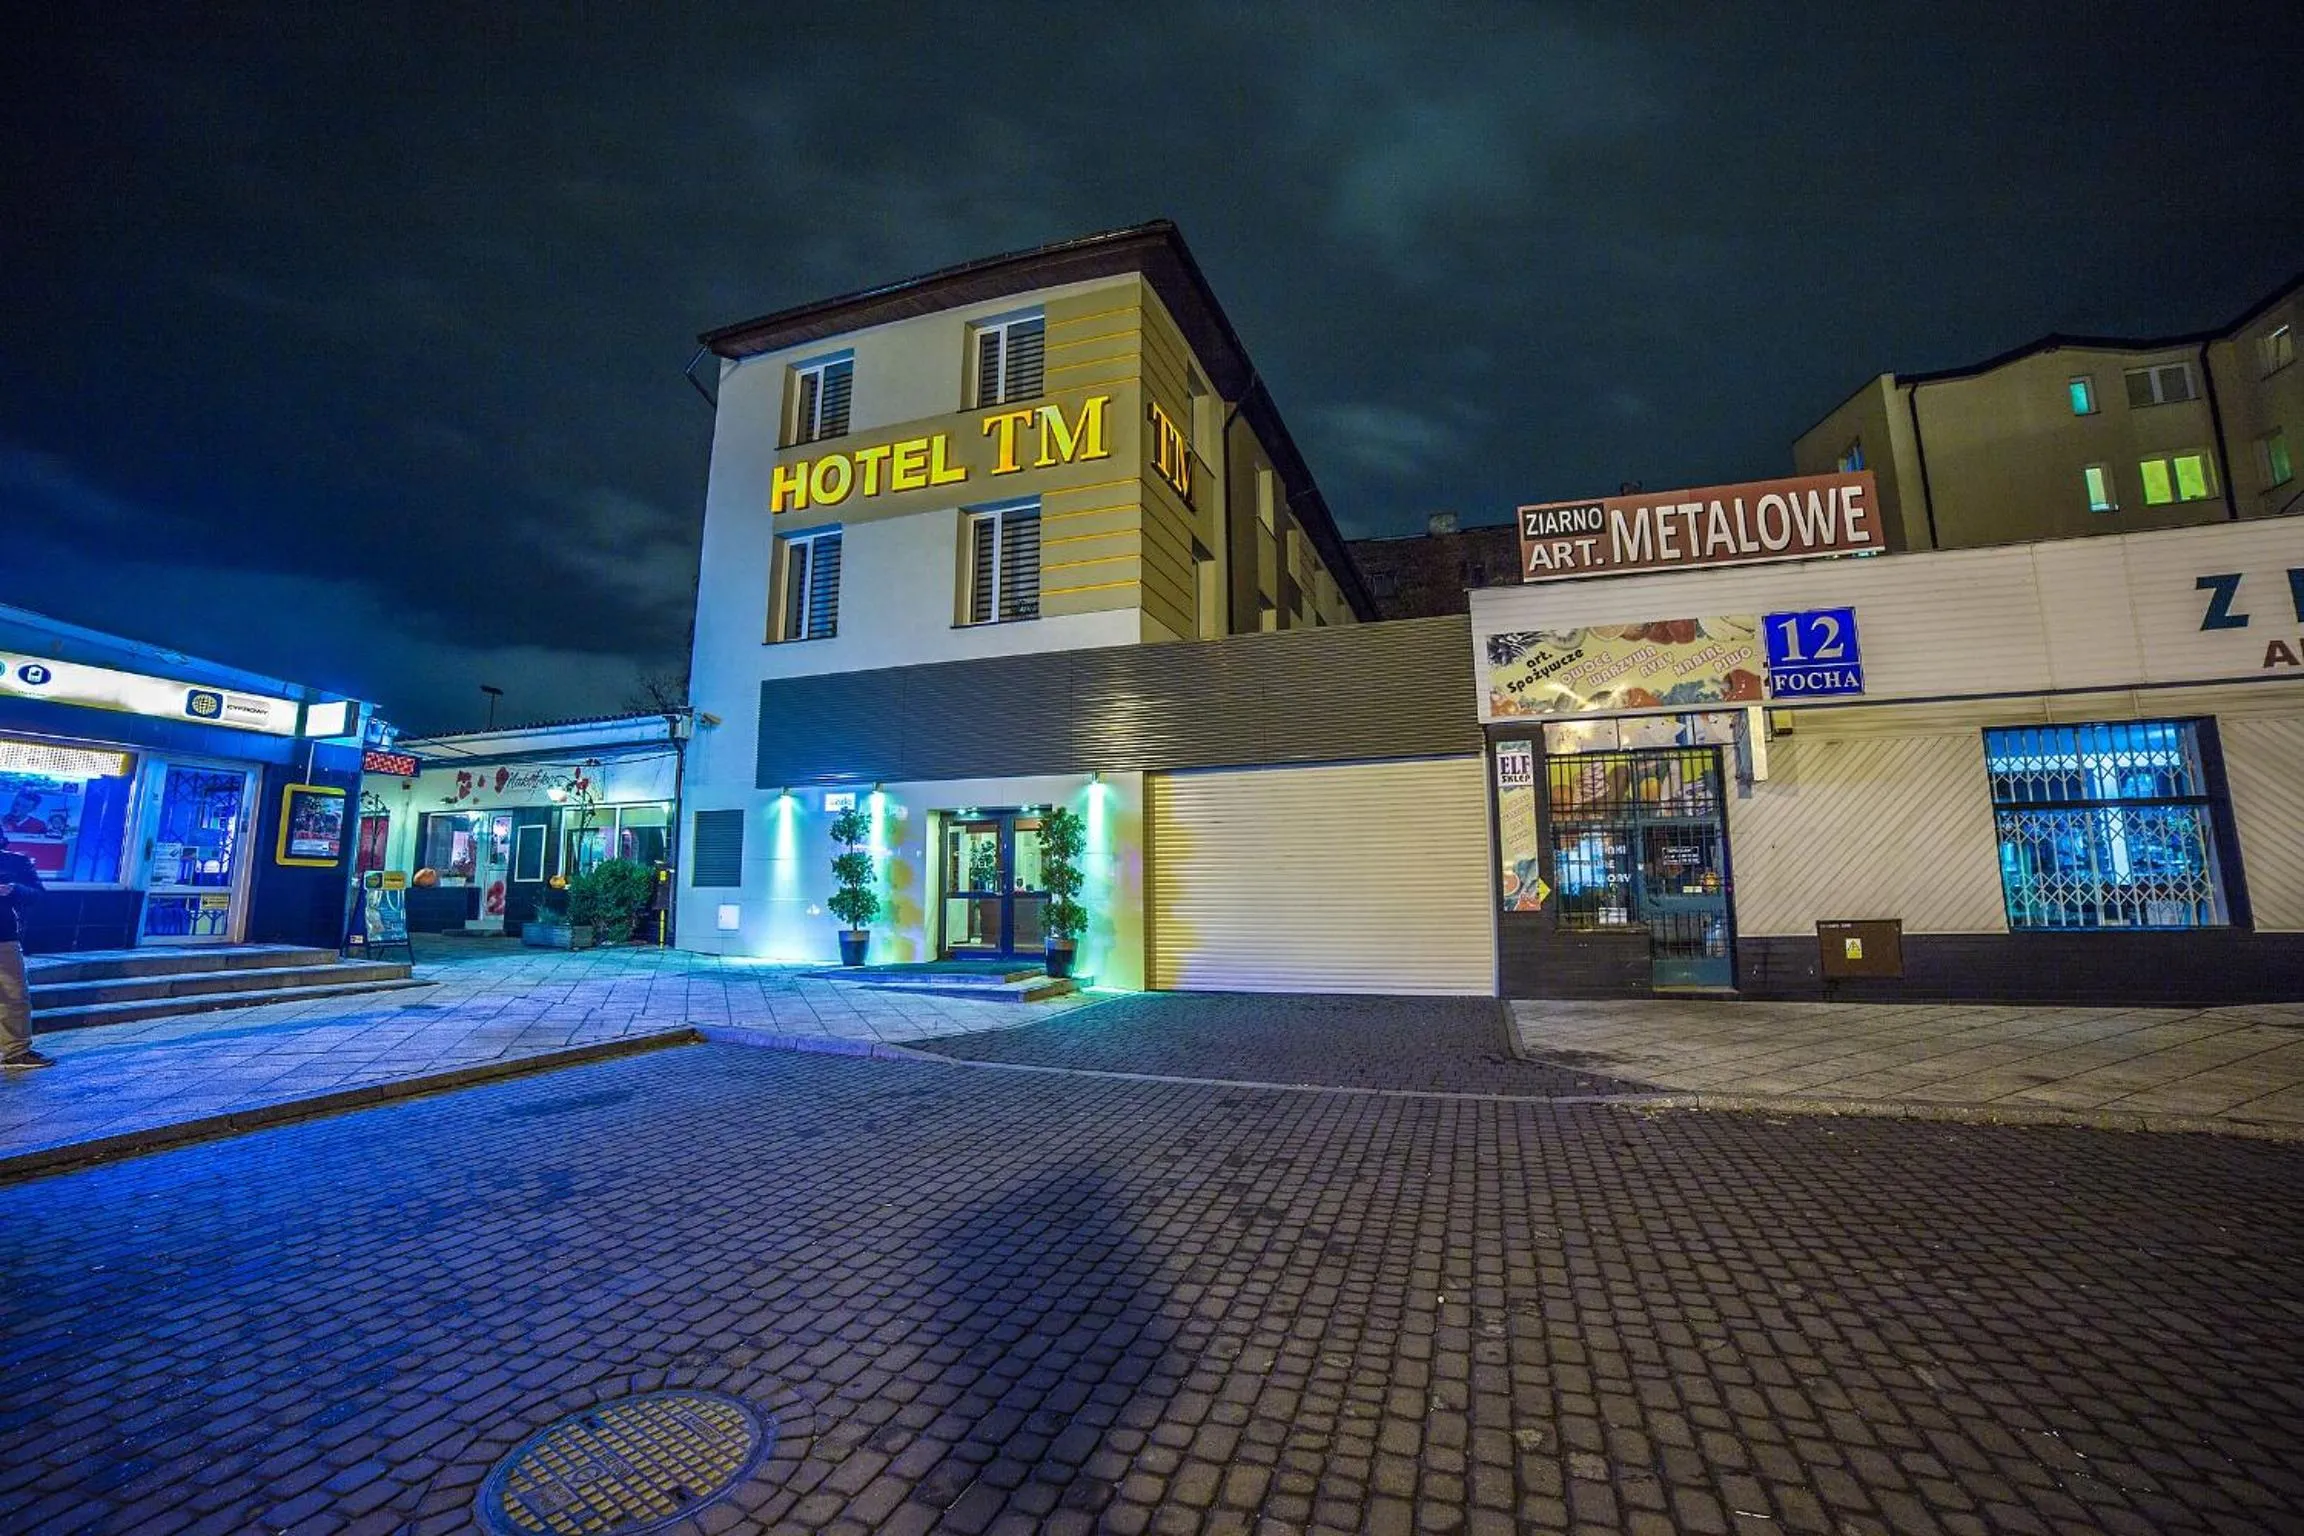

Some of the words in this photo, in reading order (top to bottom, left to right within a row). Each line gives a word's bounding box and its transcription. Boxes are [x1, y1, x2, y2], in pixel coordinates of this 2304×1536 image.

[770, 434, 967, 514] HOTEL
[983, 395, 1110, 476] TM
[1525, 507, 1603, 536] ZIARNO
[1529, 538, 1605, 571] ART.
[1610, 486, 1871, 563] METALOWE
[1777, 615, 1844, 661] 12
[1526, 650, 1553, 668] art.
[2262, 638, 2304, 669] A
[1506, 649, 1584, 693] Spożywcze
[1773, 671, 1860, 691] FOCHA
[1501, 755, 1530, 775] ELF
[1502, 775, 1530, 783] SKLEP
